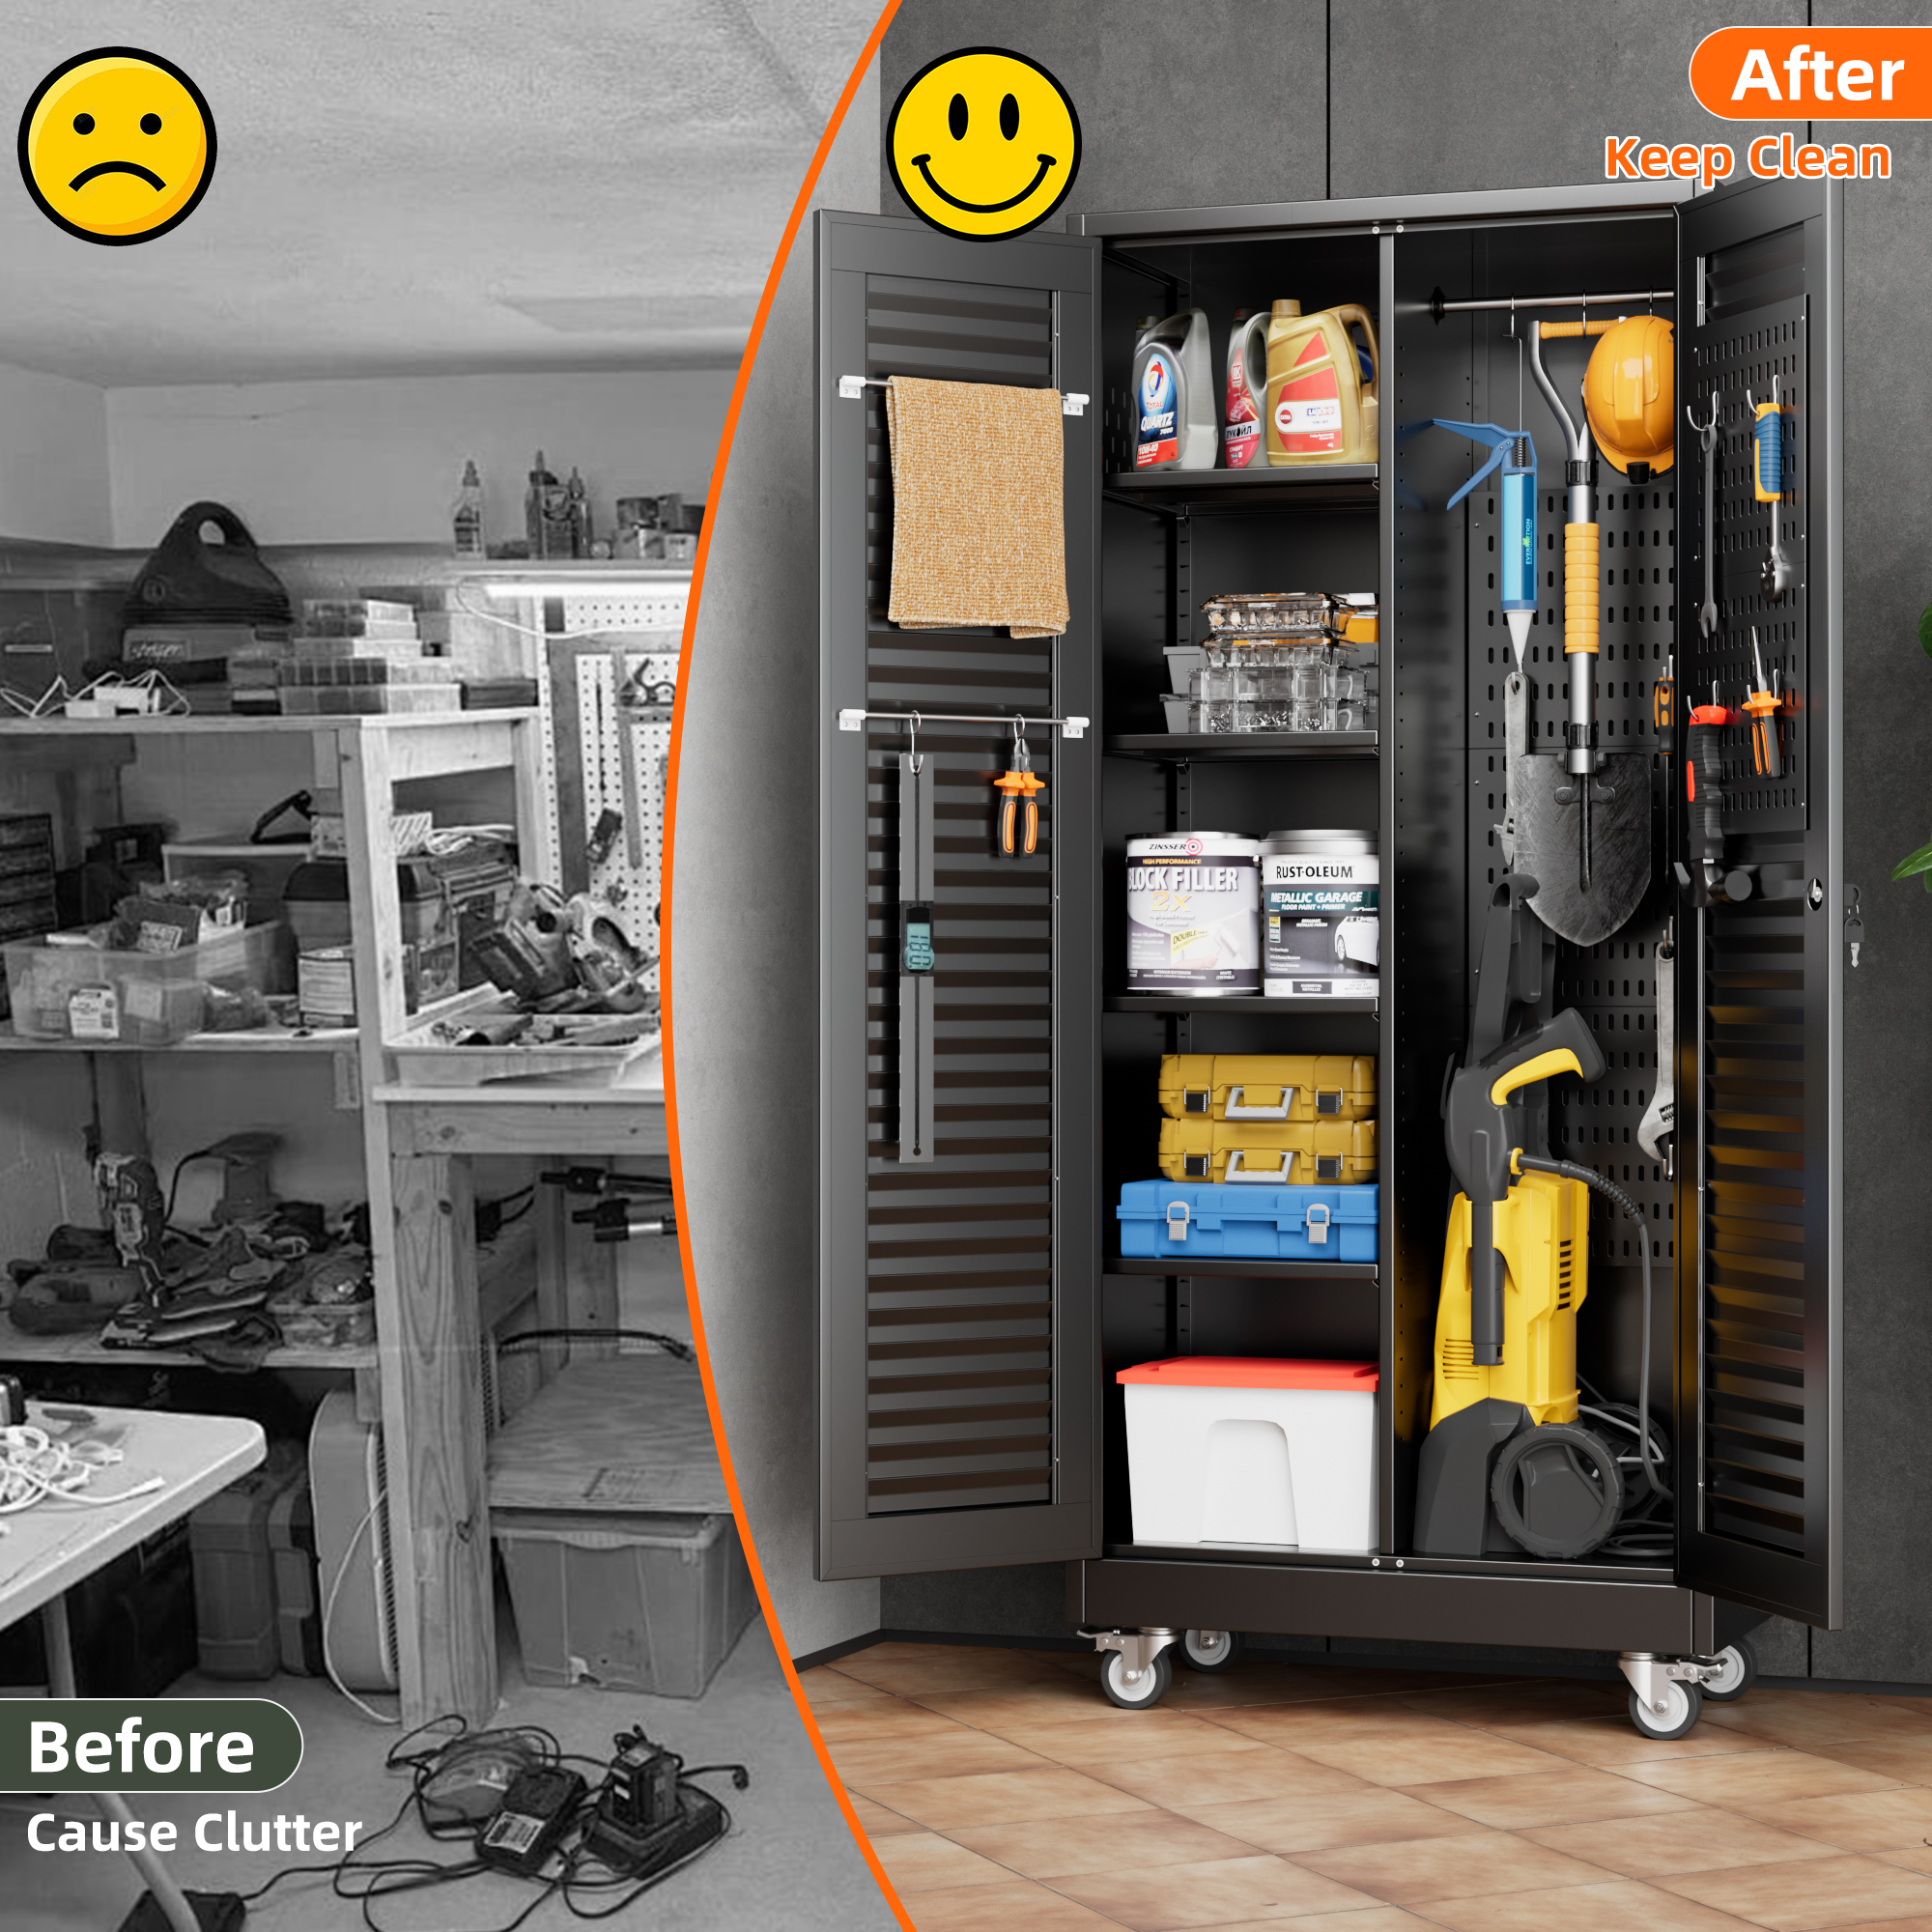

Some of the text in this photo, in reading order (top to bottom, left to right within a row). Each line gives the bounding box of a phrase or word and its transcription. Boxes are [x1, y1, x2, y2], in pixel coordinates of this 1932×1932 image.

[1146, 402, 1164, 411] TOTAL
[1141, 412, 1175, 432] QUARTZ
[1171, 867, 1238, 892] FILLER
[1270, 891, 1363, 903] METALLIC GARAGE
[1173, 930, 1197, 945] DOUBLE
